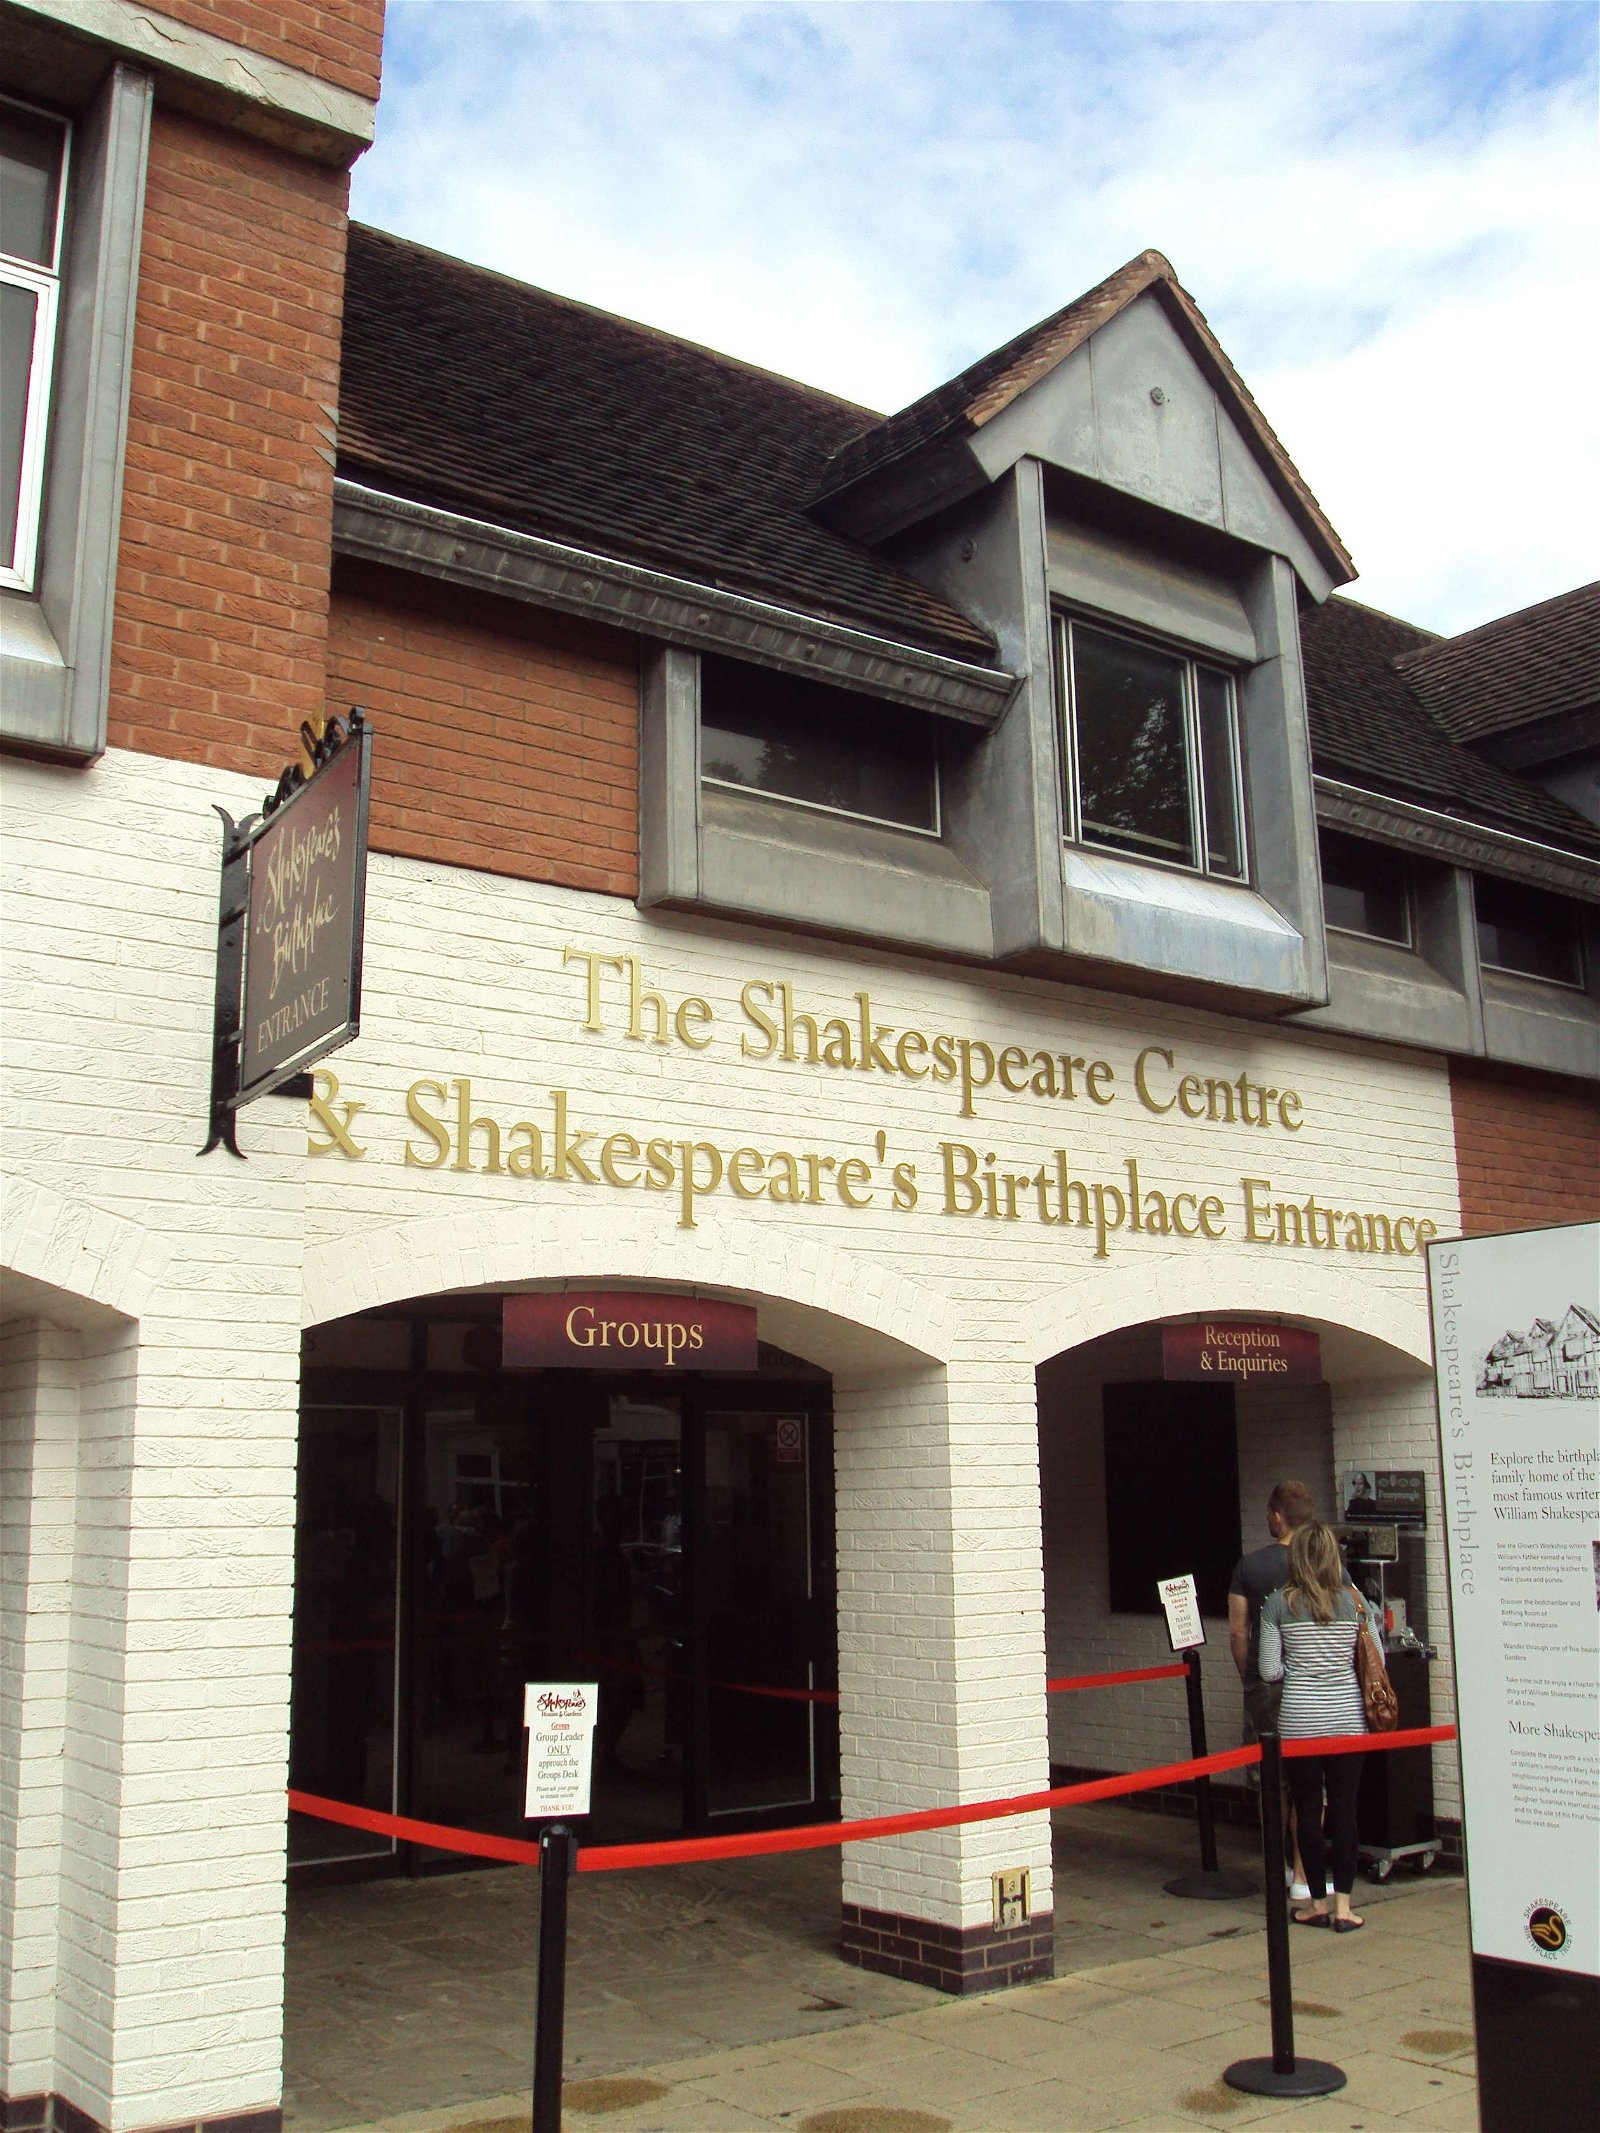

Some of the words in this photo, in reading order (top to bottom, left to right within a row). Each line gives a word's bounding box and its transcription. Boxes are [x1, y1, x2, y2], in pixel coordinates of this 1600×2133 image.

[269, 876, 340, 1000] Birthplace
[257, 976, 330, 1054] ENTRANCE
[563, 944, 713, 1050] The
[741, 979, 1115, 1117] Shakespeare
[1135, 1046, 1304, 1131] Centre
[307, 1068, 367, 1158] &
[406, 1078, 918, 1229] Shakespeare's
[939, 1141, 1226, 1259] Birthplace
[1241, 1177, 1438, 1256] Entrance
[565, 1305, 703, 1366] Groups
[1205, 1325, 1281, 1354] Reception
[1439, 1253, 1470, 1438] Shakespeare's
[1200, 1351, 1213, 1371] &
[1217, 1351, 1288, 1380] Enquiries
[1490, 1451, 1534, 1468] Explore
[1537, 1450, 1554, 1464] the
[1492, 1469, 1525, 1487] family
[1528, 1469, 1559, 1482] home
[1563, 1467, 1575, 1481] of
[1577, 1467, 1595, 1481] the
[1493, 1491, 1519, 1501] most
[1522, 1487, 1563, 1501] famous
[1452, 1452, 1479, 1595] Birthplace
[1494, 1506, 1538, 1520] William
[536, 1732, 559, 1743] Group
[560, 1732, 584, 1741] Leader
[1509, 1720, 1540, 1736] More
[547, 1744, 572, 1755] ONLY
[537, 1770, 561, 1780] Groups
[562, 1769, 579, 1778] Desk
[538, 1758, 568, 1769] approach
[569, 1757, 579, 1766] the
[540, 1804, 560, 1812] THANK
[562, 1803, 575, 1811] YOU
[1009, 1880, 1016, 1892] 3
[1523, 1898, 1572, 1925] SHAKESPEARE
[1523, 1925, 1558, 1960] BIRTHPLACE
[1561, 1933, 1573, 1956] TRUST
